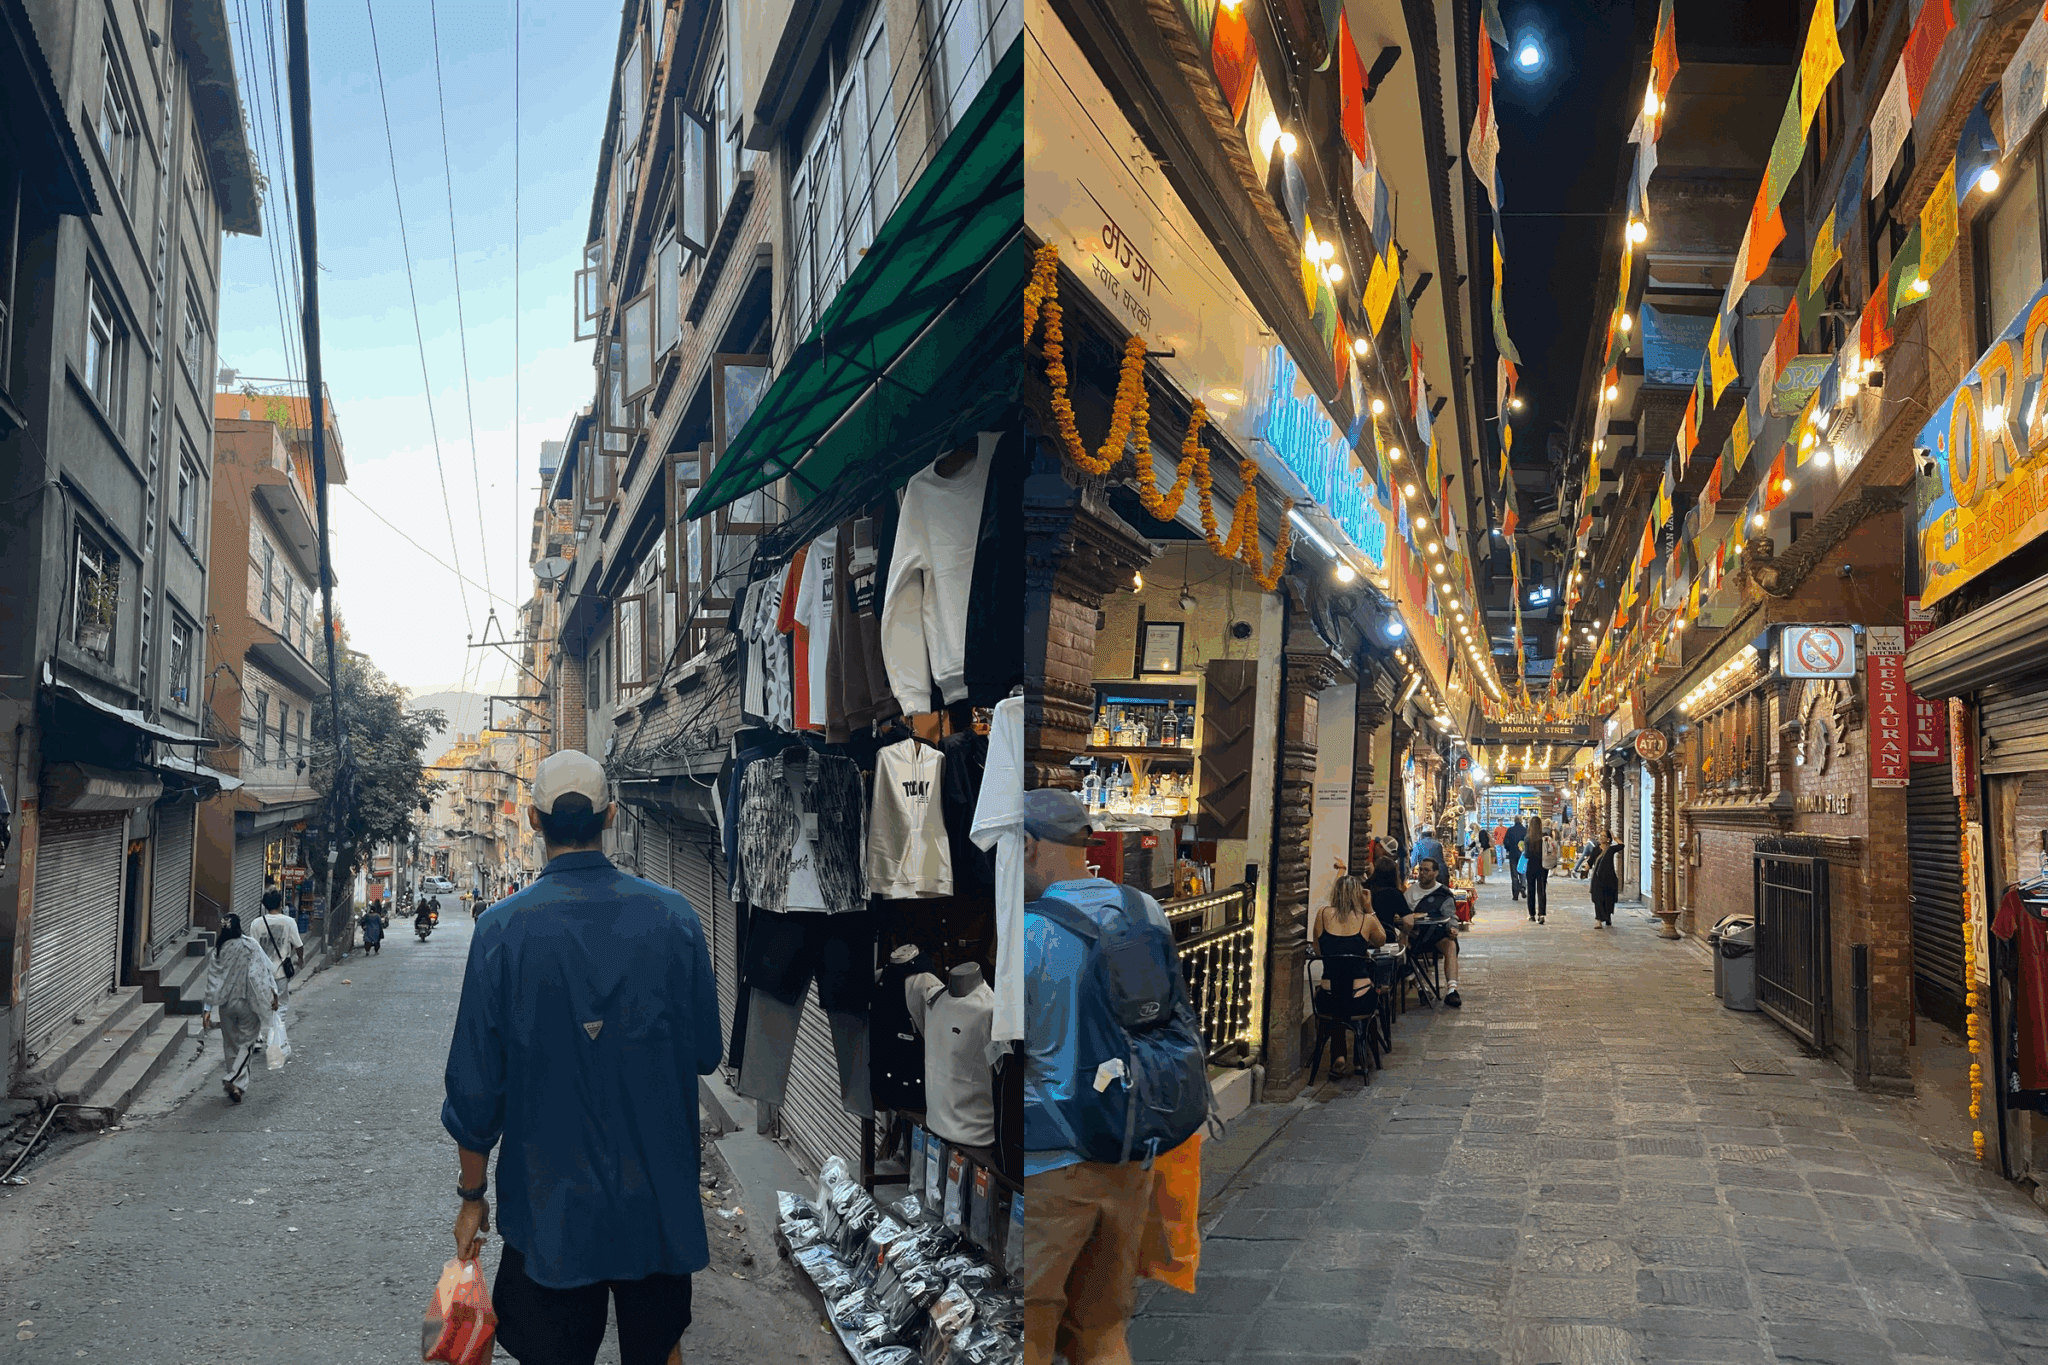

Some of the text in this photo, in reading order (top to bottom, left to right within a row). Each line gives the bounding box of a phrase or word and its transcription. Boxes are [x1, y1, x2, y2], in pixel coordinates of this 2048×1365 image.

[1092, 252, 1120, 301] स्वाद
[1501, 726, 1574, 734] MANDALA STREET
[1877, 656, 1901, 777] RESTAURANT
[1970, 833, 1985, 954] OR2K
